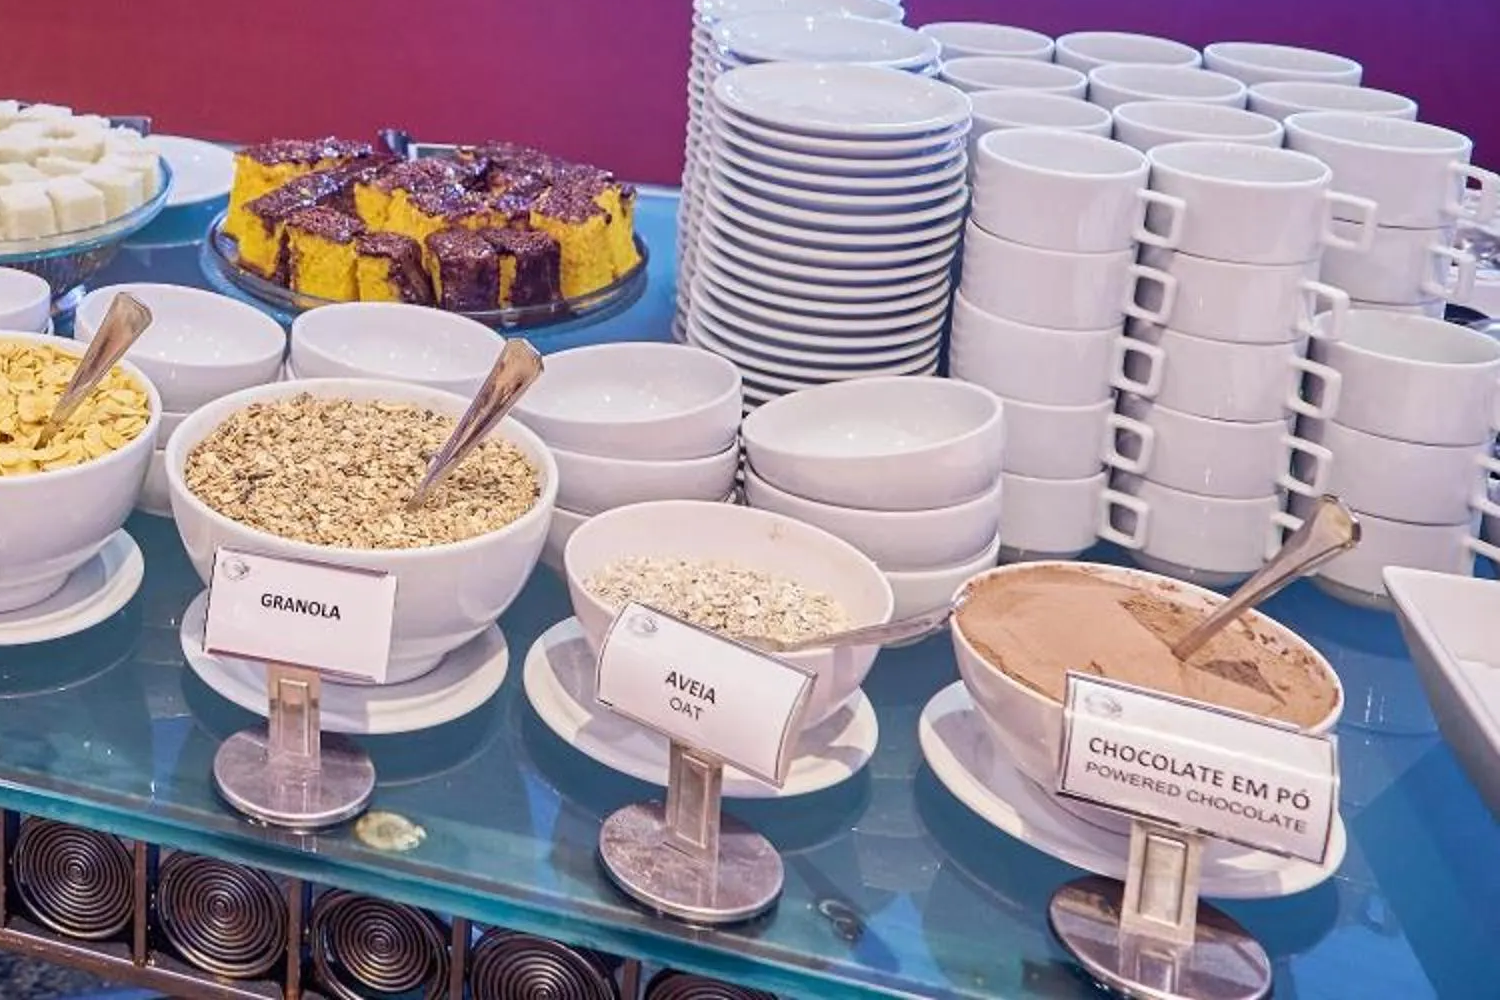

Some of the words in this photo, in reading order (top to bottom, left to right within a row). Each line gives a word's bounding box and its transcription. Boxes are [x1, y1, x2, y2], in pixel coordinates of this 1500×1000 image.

[260, 592, 341, 620] GRANOLA
[664, 670, 716, 705] AVEIA
[669, 696, 704, 721] OAT
[1088, 737, 1225, 788] CHOCOLATE
[1231, 775, 1268, 800] EM
[1277, 788, 1311, 811] PÓ
[1085, 760, 1181, 798] POWERED
[1186, 788, 1308, 834] CHOCOLATE
